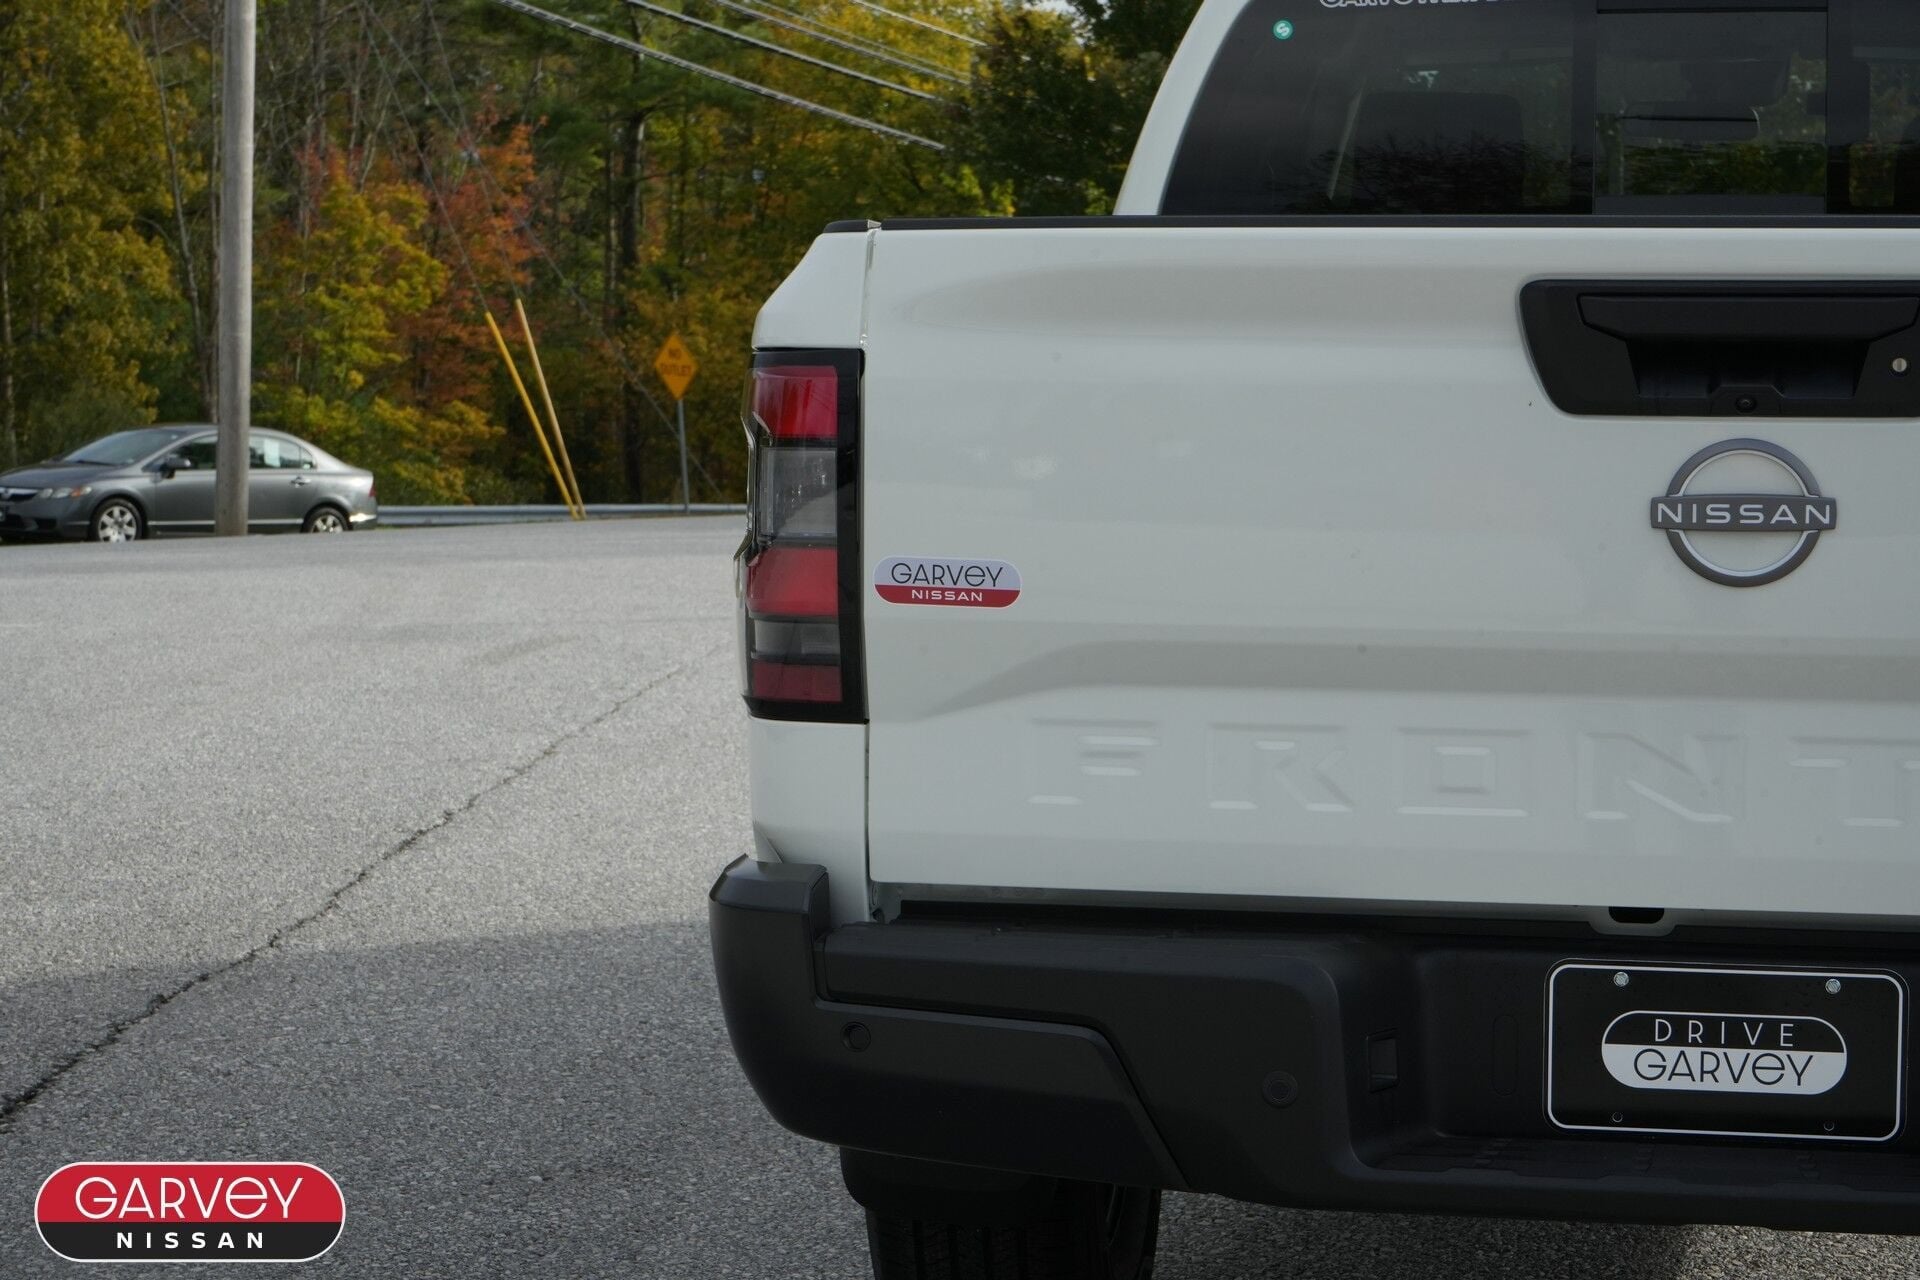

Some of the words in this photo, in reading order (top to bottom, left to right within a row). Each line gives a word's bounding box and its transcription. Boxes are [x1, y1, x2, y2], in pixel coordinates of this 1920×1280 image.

[1657, 503, 1831, 525] NISSAN
[911, 589, 983, 602] NISSAN
[1654, 1018, 1794, 1047] DRIVE
